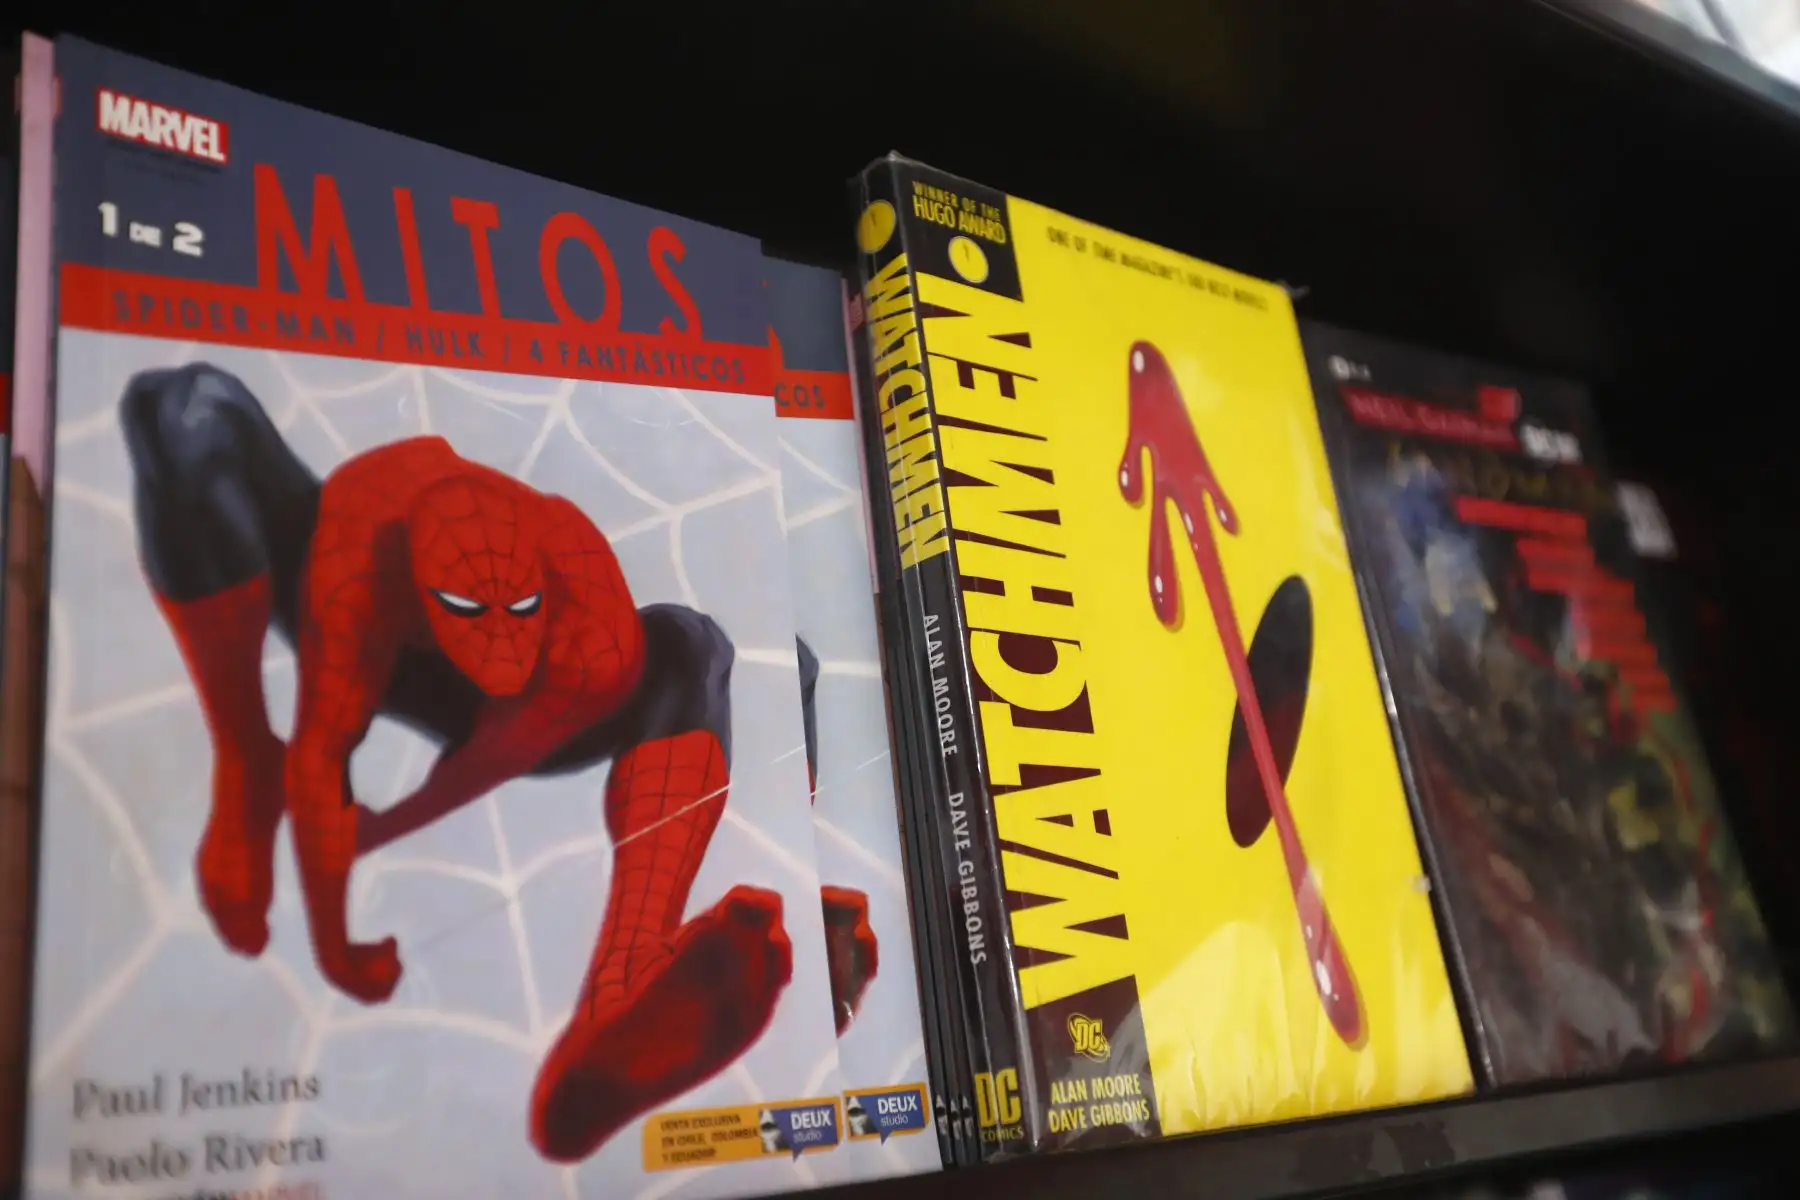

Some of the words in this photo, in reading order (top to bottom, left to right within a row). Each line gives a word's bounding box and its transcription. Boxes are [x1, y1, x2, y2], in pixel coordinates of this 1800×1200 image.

[99, 90, 226, 163] MARVEL
[911, 180, 958, 208] WINNER
[912, 194, 956, 229] HUGO
[959, 209, 1006, 245] AWARD
[98, 202, 117, 237] 1
[129, 221, 161, 247] DE
[172, 221, 204, 257] 2
[253, 162, 702, 336] MITOS
[113, 290, 357, 346] SPIDER-MAN
[405, 326, 485, 362] HULK
[529, 338, 544, 364] 4
[864, 252, 950, 571] WATCHMEN
[916, 270, 1136, 1012] WATCHMEN
[923, 612, 946, 672] ALAN
[932, 676, 959, 758] MOORE
[948, 792, 972, 850] DAVE
[957, 861, 987, 964] GIBBONS
[72, 1074, 163, 1119] Paul
[178, 1069, 322, 1117] Jenkins
[877, 1096, 918, 1115] DEUX
[974, 1067, 1022, 1127] DC
[1051, 1080, 1087, 1104] ALAN
[1091, 1073, 1141, 1099] MOORE
[791, 1109, 832, 1129] DEUX
[793, 1131, 822, 1144] studio
[880, 1114, 908, 1127] studio
[980, 1126, 1024, 1143] COMICS
[1048, 1107, 1087, 1133] DAVE
[1090, 1099, 1150, 1127] GIBBONS
[69, 1140, 192, 1186] Paolo
[204, 1132, 325, 1174] Rivera
